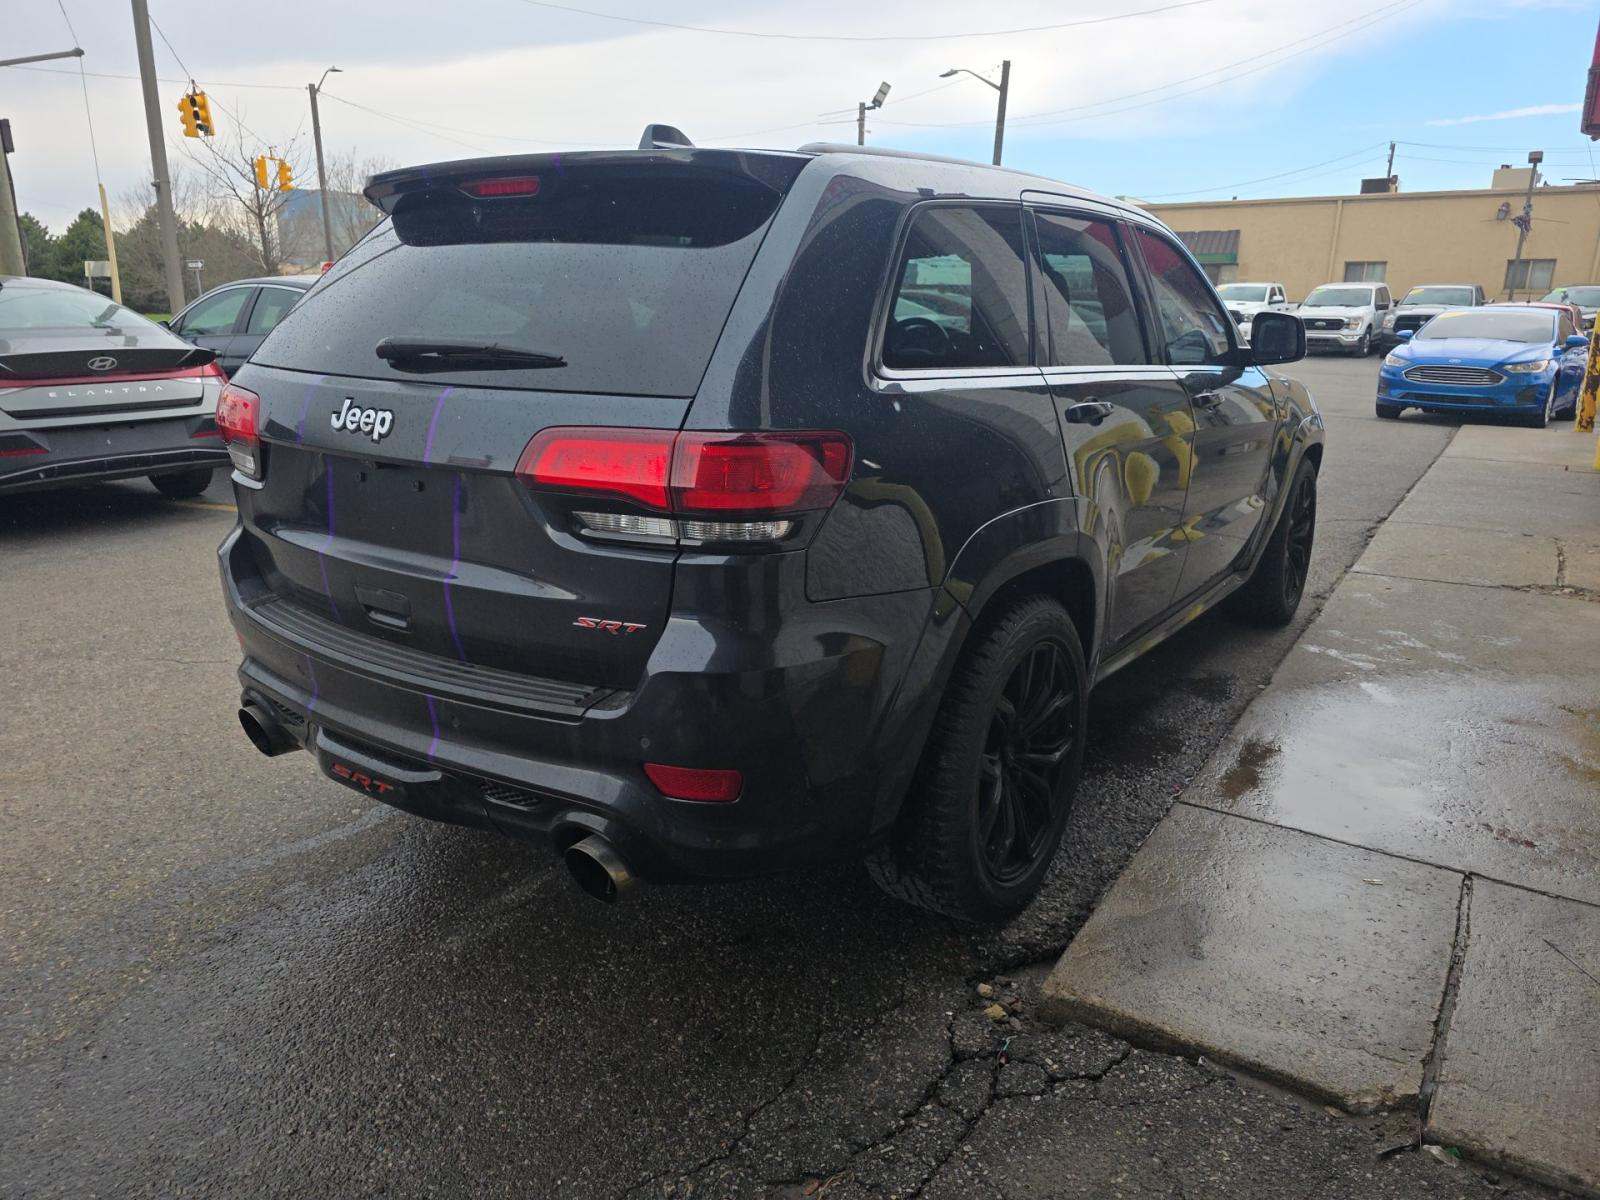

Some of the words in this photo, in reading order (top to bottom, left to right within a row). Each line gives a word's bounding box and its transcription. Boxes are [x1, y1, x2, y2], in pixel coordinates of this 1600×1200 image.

[48, 385, 163, 398] ELANTRA
[330, 398, 393, 441] Jeep
[572, 617, 648, 635] SRT
[330, 763, 394, 793] SRT
